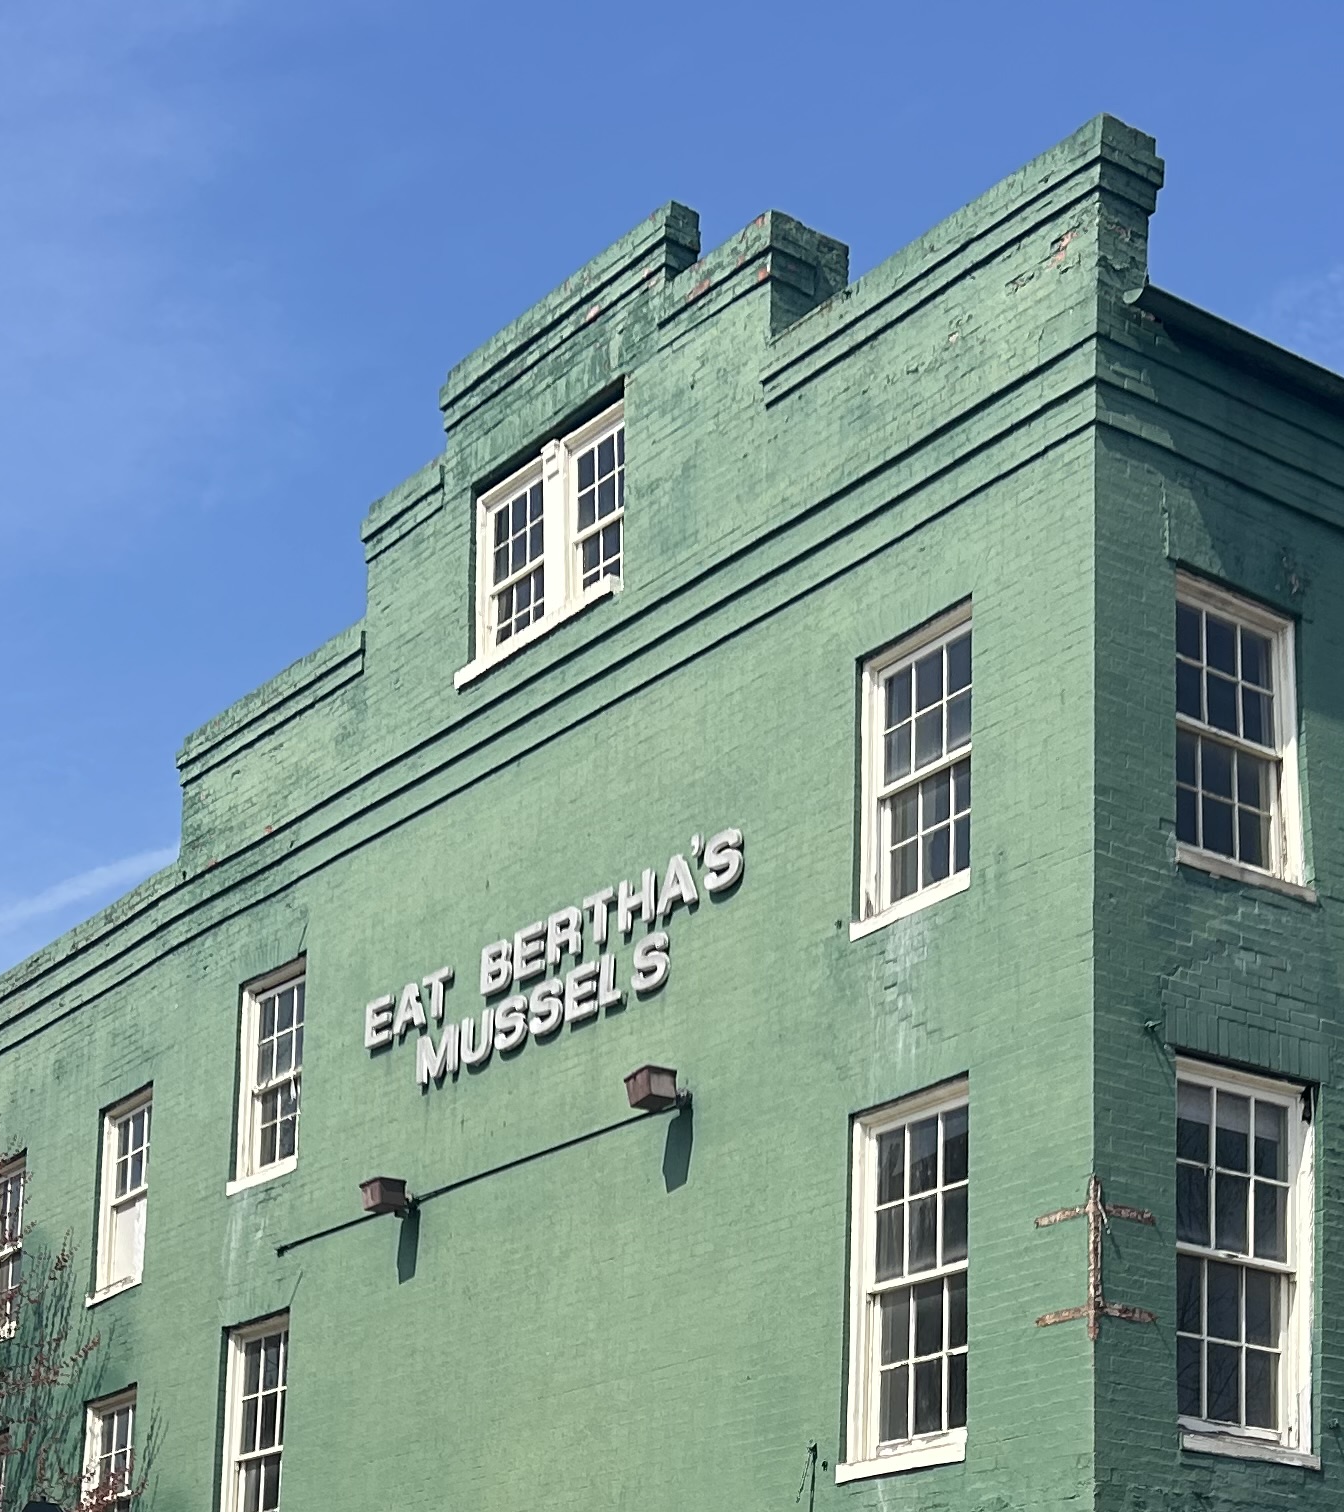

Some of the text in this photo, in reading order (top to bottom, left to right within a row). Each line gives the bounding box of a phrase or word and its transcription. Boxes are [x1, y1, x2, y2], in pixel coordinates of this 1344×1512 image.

[364, 827, 743, 1049] EAT BERTHA'S
[416, 931, 670, 1085] MUSSELS
